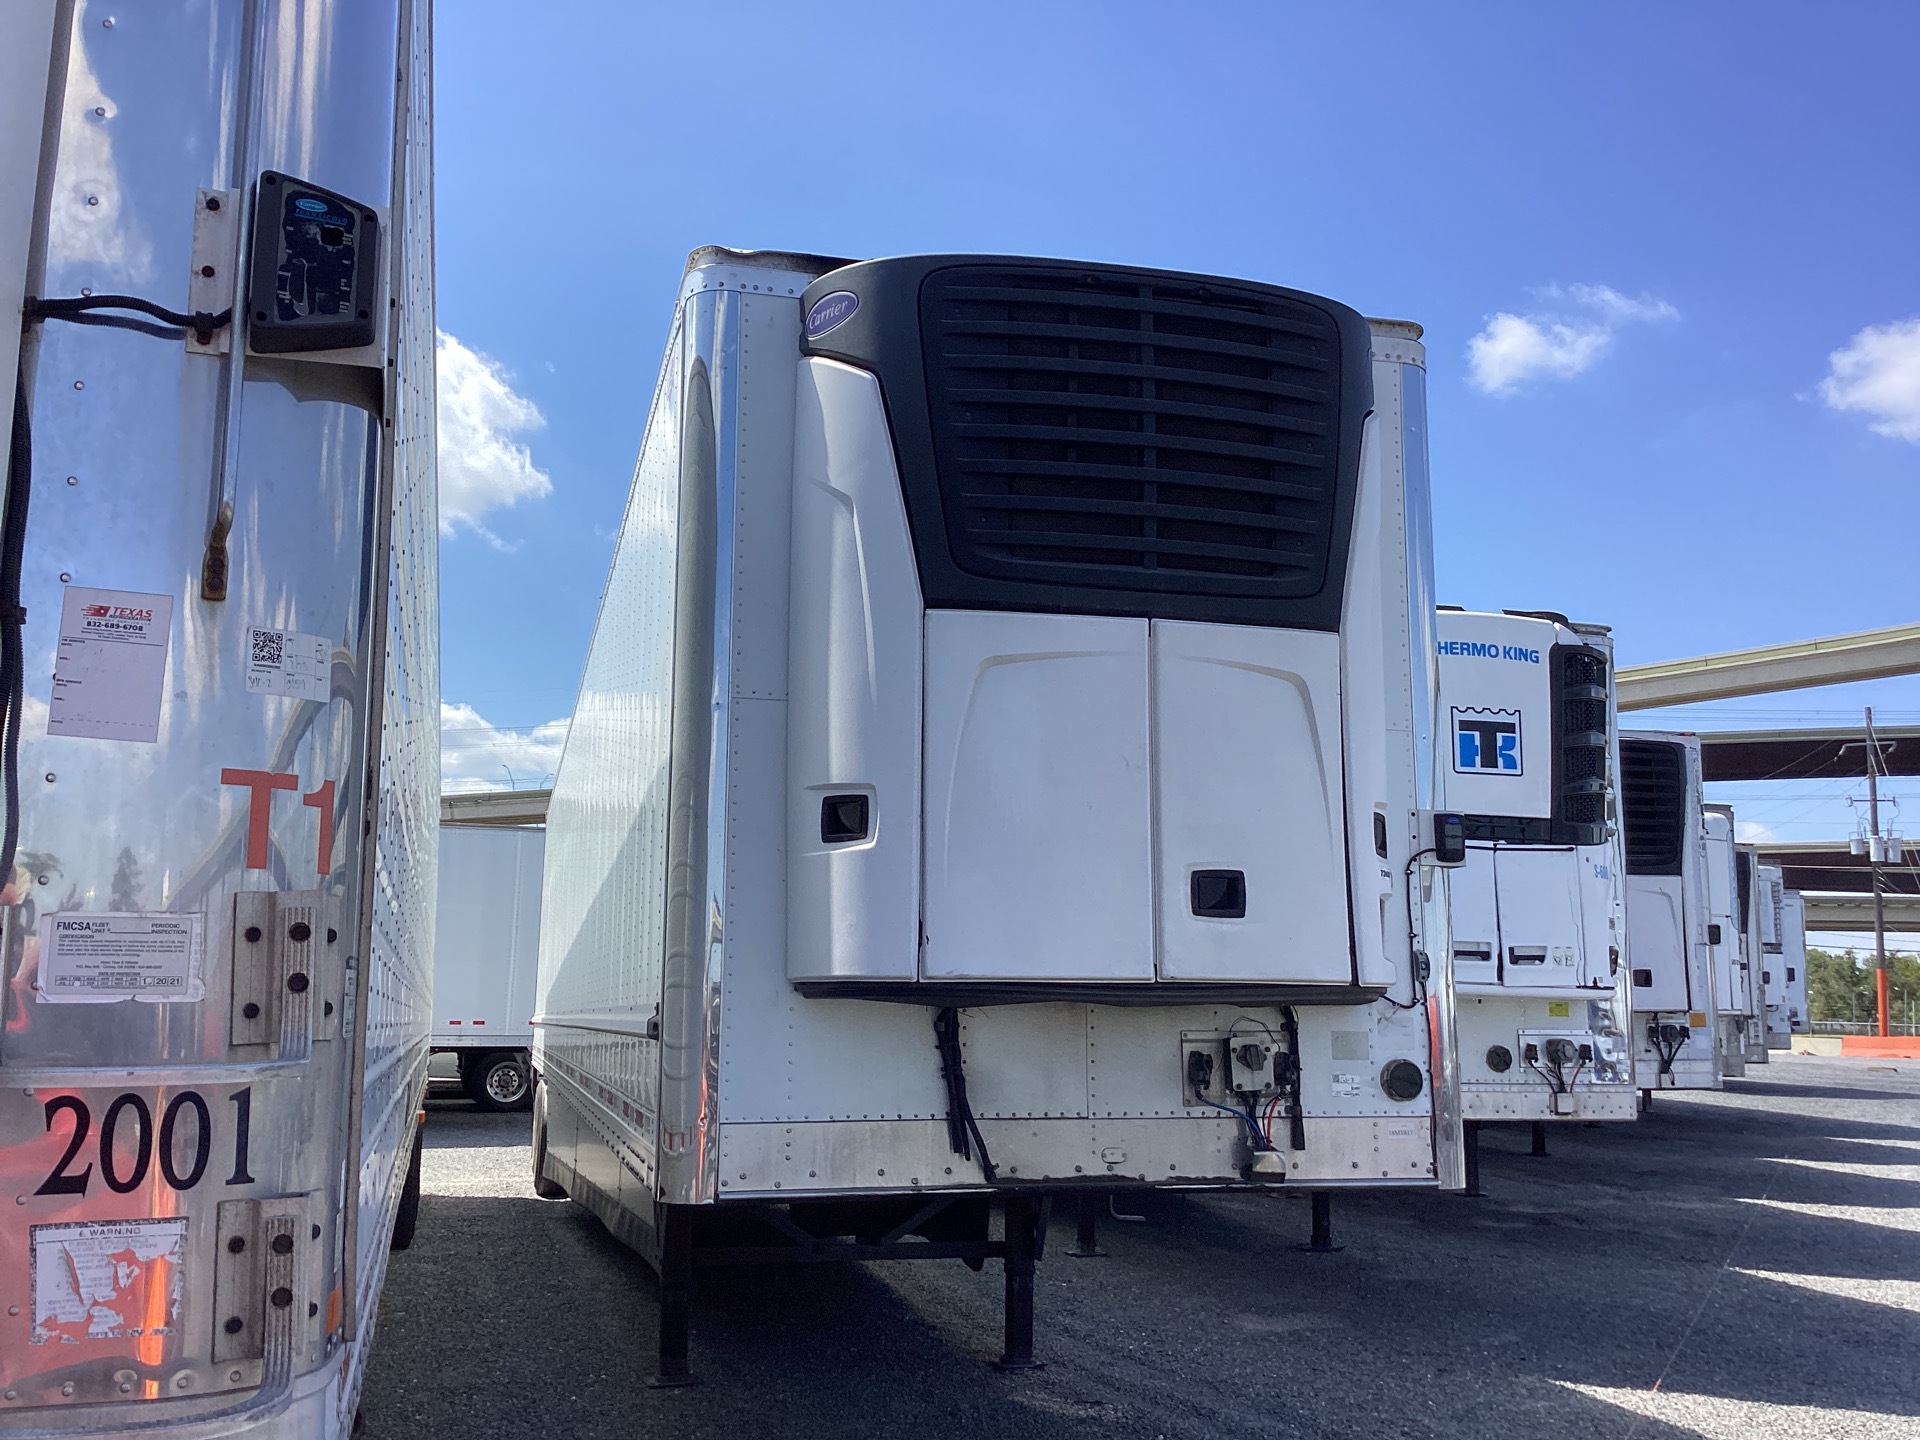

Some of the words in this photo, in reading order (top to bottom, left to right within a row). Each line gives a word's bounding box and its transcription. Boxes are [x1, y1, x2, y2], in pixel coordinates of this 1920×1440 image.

[809, 301, 848, 330] Carrier
[113, 606, 153, 618] TEXAS
[86, 620, 144, 632] 832-689-6708
[1437, 641, 1499, 659] HERMO
[1503, 645, 1540, 664] KING
[56, 921, 91, 931] FMCSA
[143, 977, 152, 985] 1
[156, 977, 167, 985] 20
[169, 977, 180, 985] 21
[33, 1086, 256, 1198] 2001
[89, 1226, 142, 1237] WARNNG
